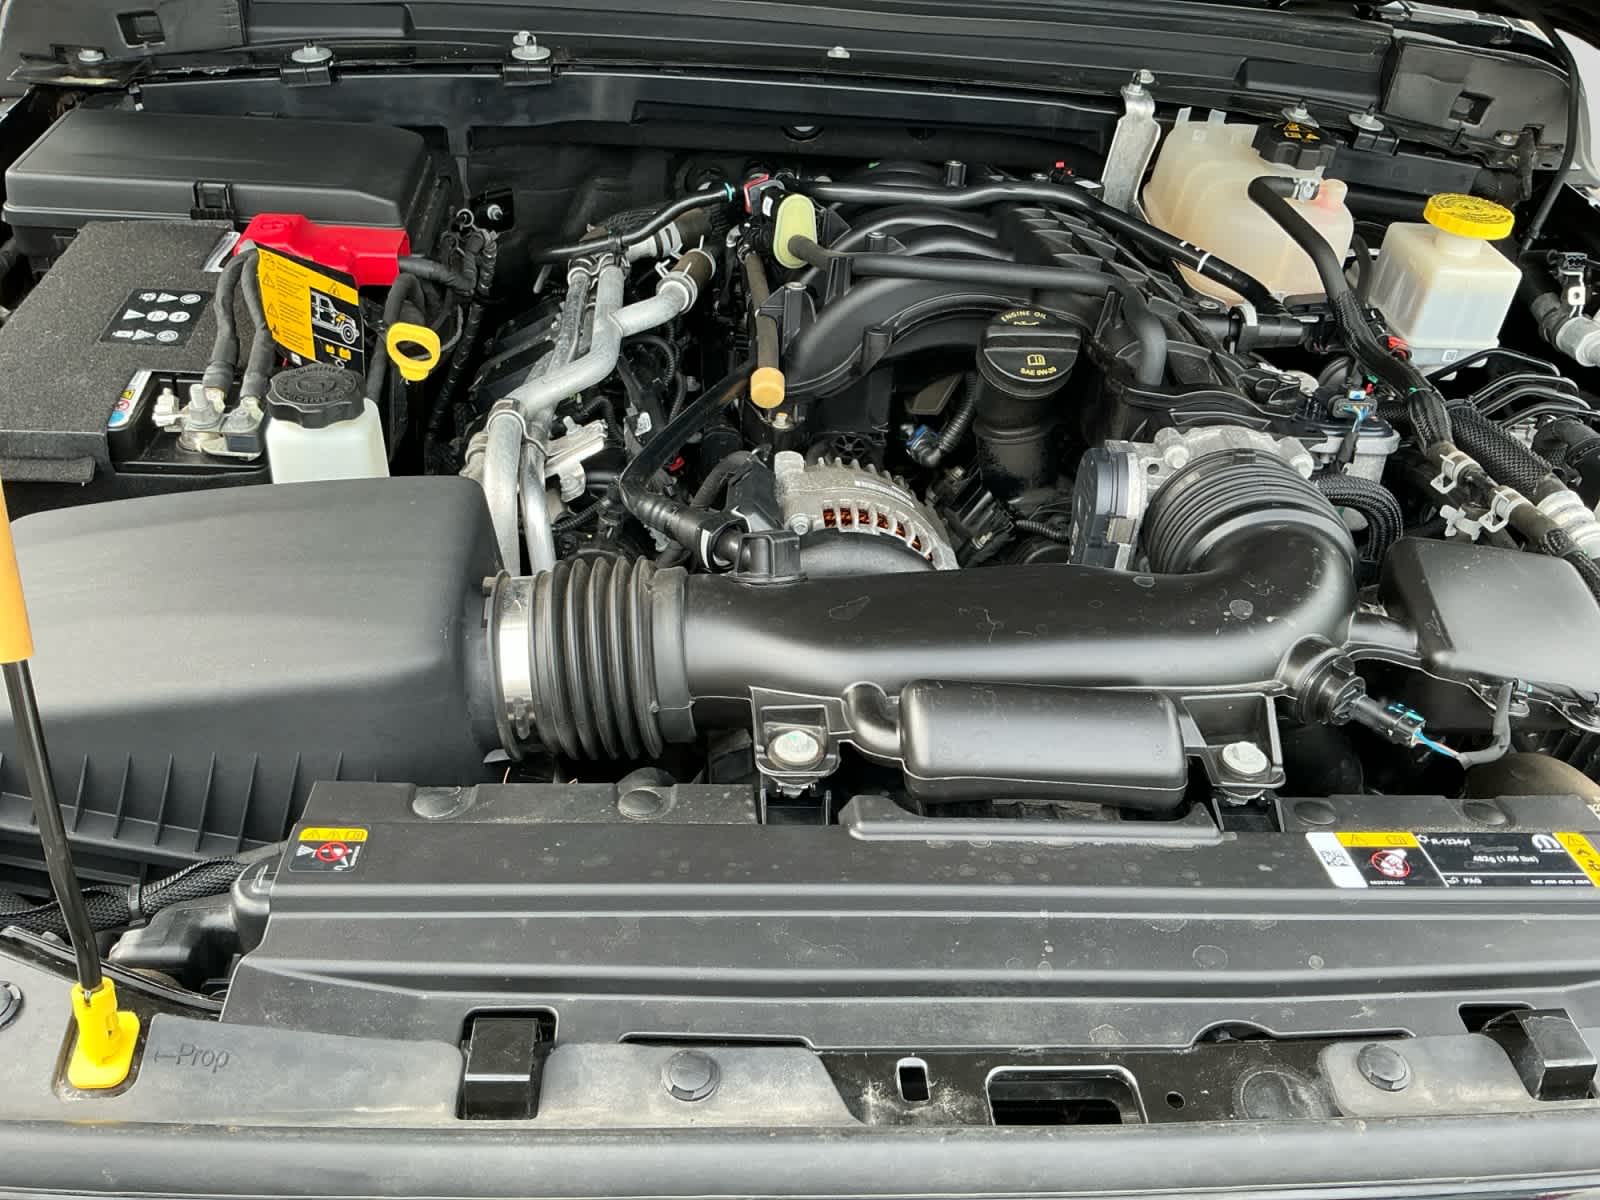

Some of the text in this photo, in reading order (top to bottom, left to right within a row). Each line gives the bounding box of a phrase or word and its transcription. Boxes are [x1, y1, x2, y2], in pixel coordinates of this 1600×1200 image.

[1001, 311, 1048, 322] ENGINE OIL
[1020, 367, 1035, 376] SAE
[175, 1041, 230, 1073] Prop
